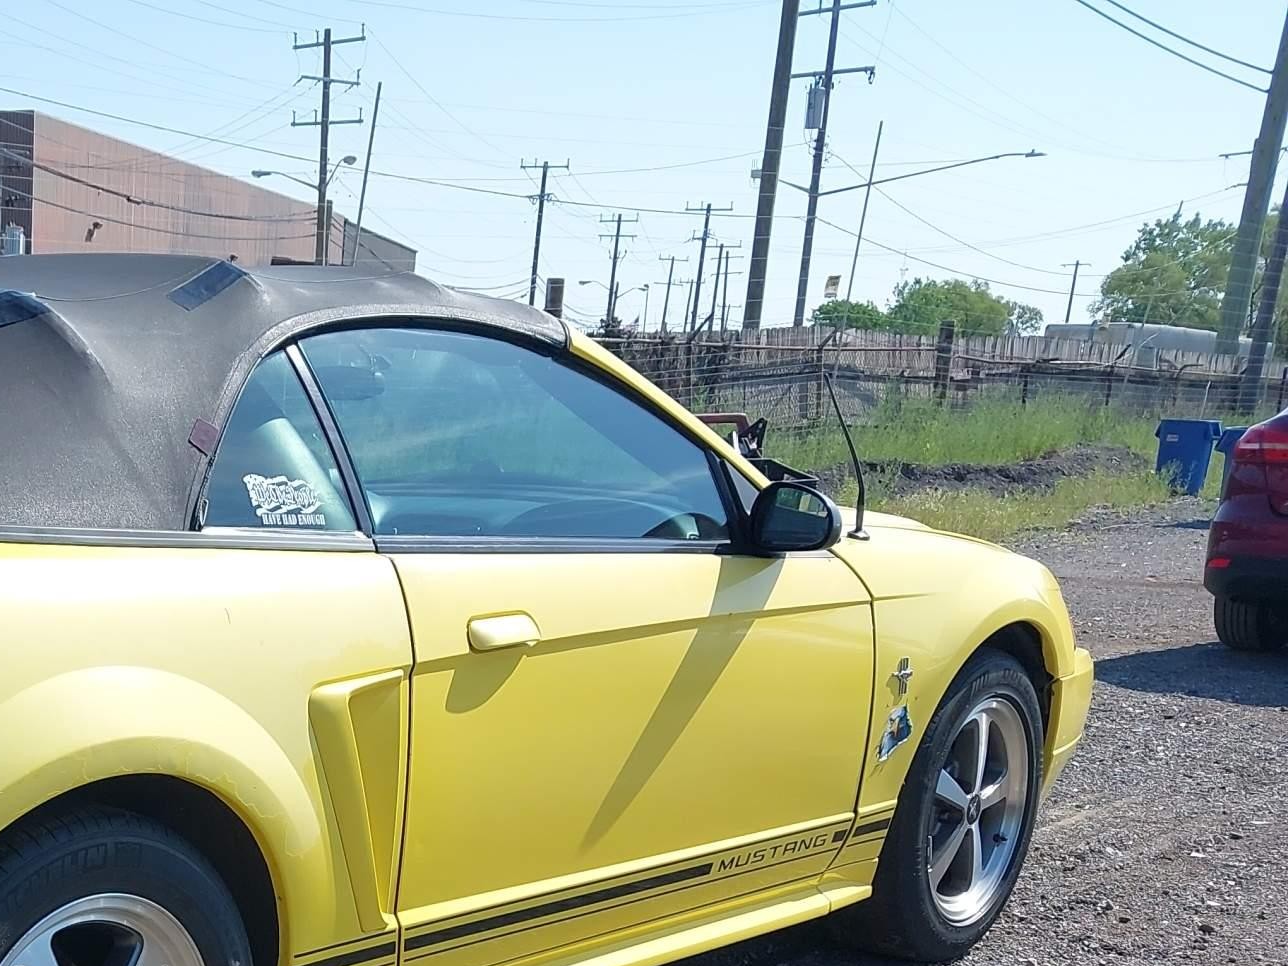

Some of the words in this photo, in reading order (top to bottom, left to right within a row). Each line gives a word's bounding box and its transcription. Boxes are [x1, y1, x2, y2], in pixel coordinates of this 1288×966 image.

[262, 513, 282, 525] HAVE
[282, 513, 298, 525] HAD
[298, 513, 326, 526] ENOUGH
[717, 833, 828, 873] MUSTANG
